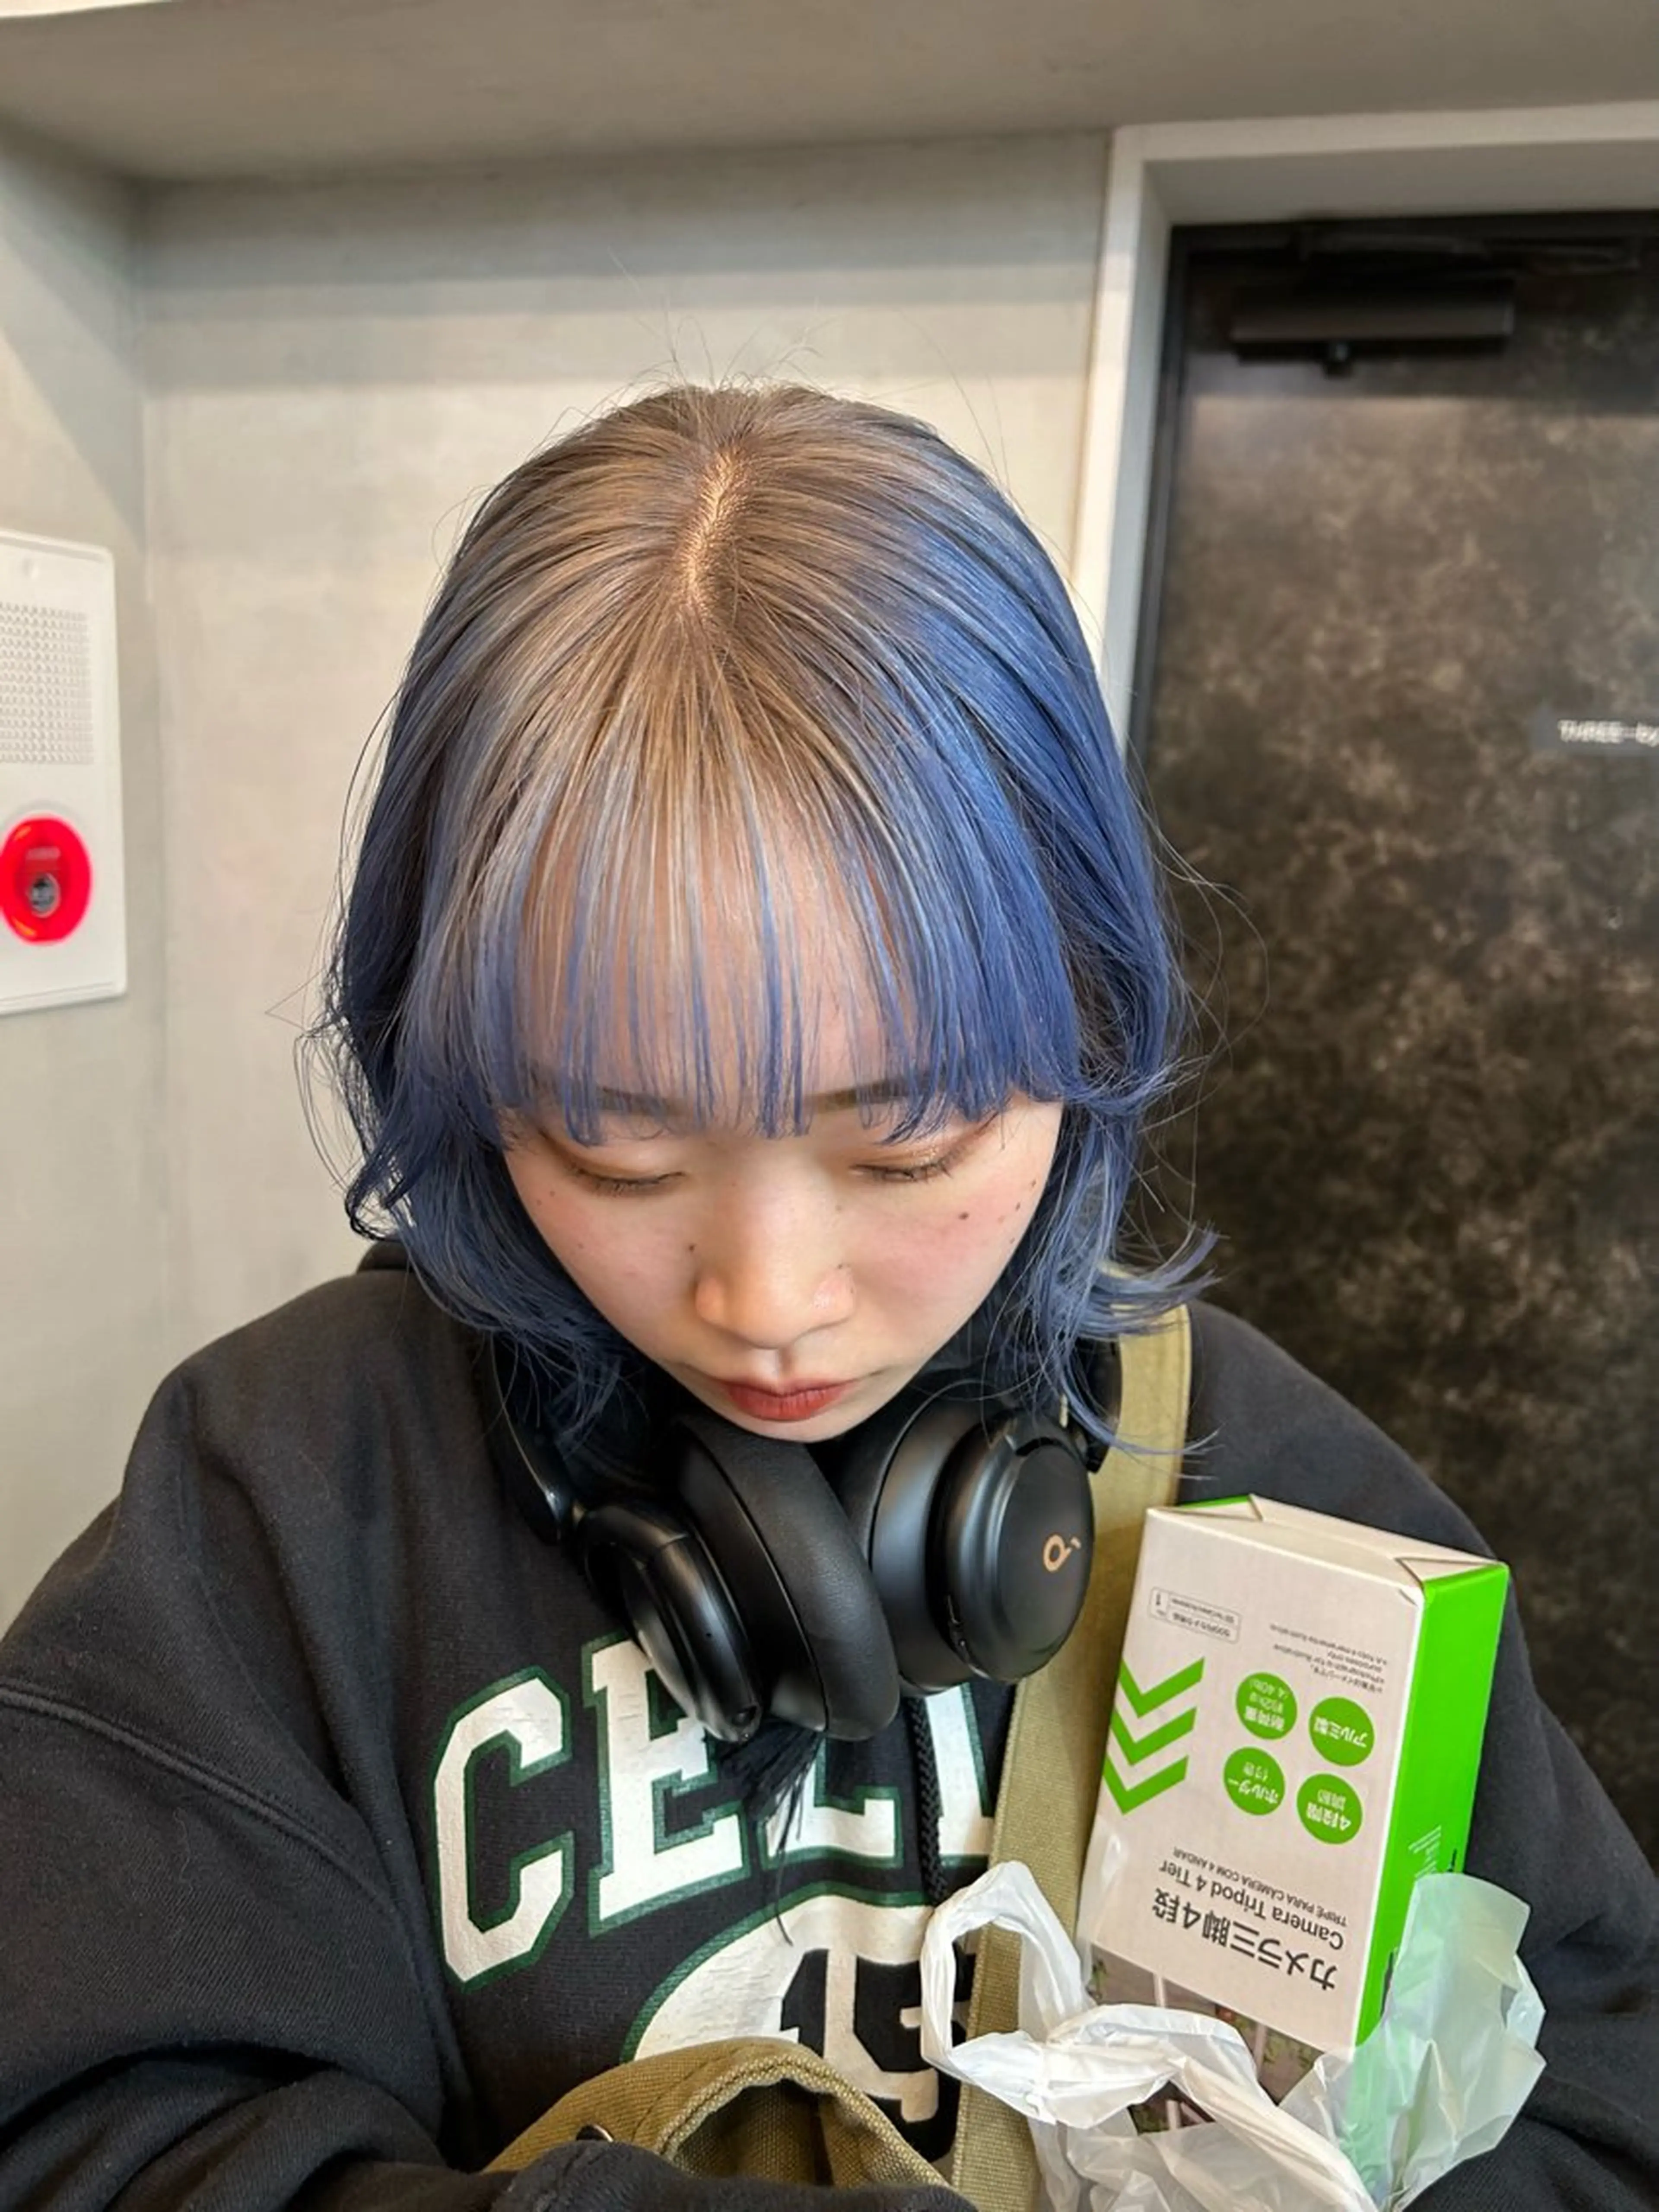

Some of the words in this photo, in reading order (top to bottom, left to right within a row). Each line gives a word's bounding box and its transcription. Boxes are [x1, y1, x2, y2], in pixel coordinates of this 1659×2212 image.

[1159, 1861, 1190, 1888] Tier
[1197, 1875, 1207, 1891] 4
[1217, 1866, 1239, 1881] COM
[1211, 1881, 1266, 1920] Tripod
[1287, 1894, 1314, 1913] PARA
[1272, 1907, 1343, 1950] Camera
[1316, 1906, 1346, 1927] TRIPÉ
[1152, 1888, 1337, 1990] カメラ三脚4段
